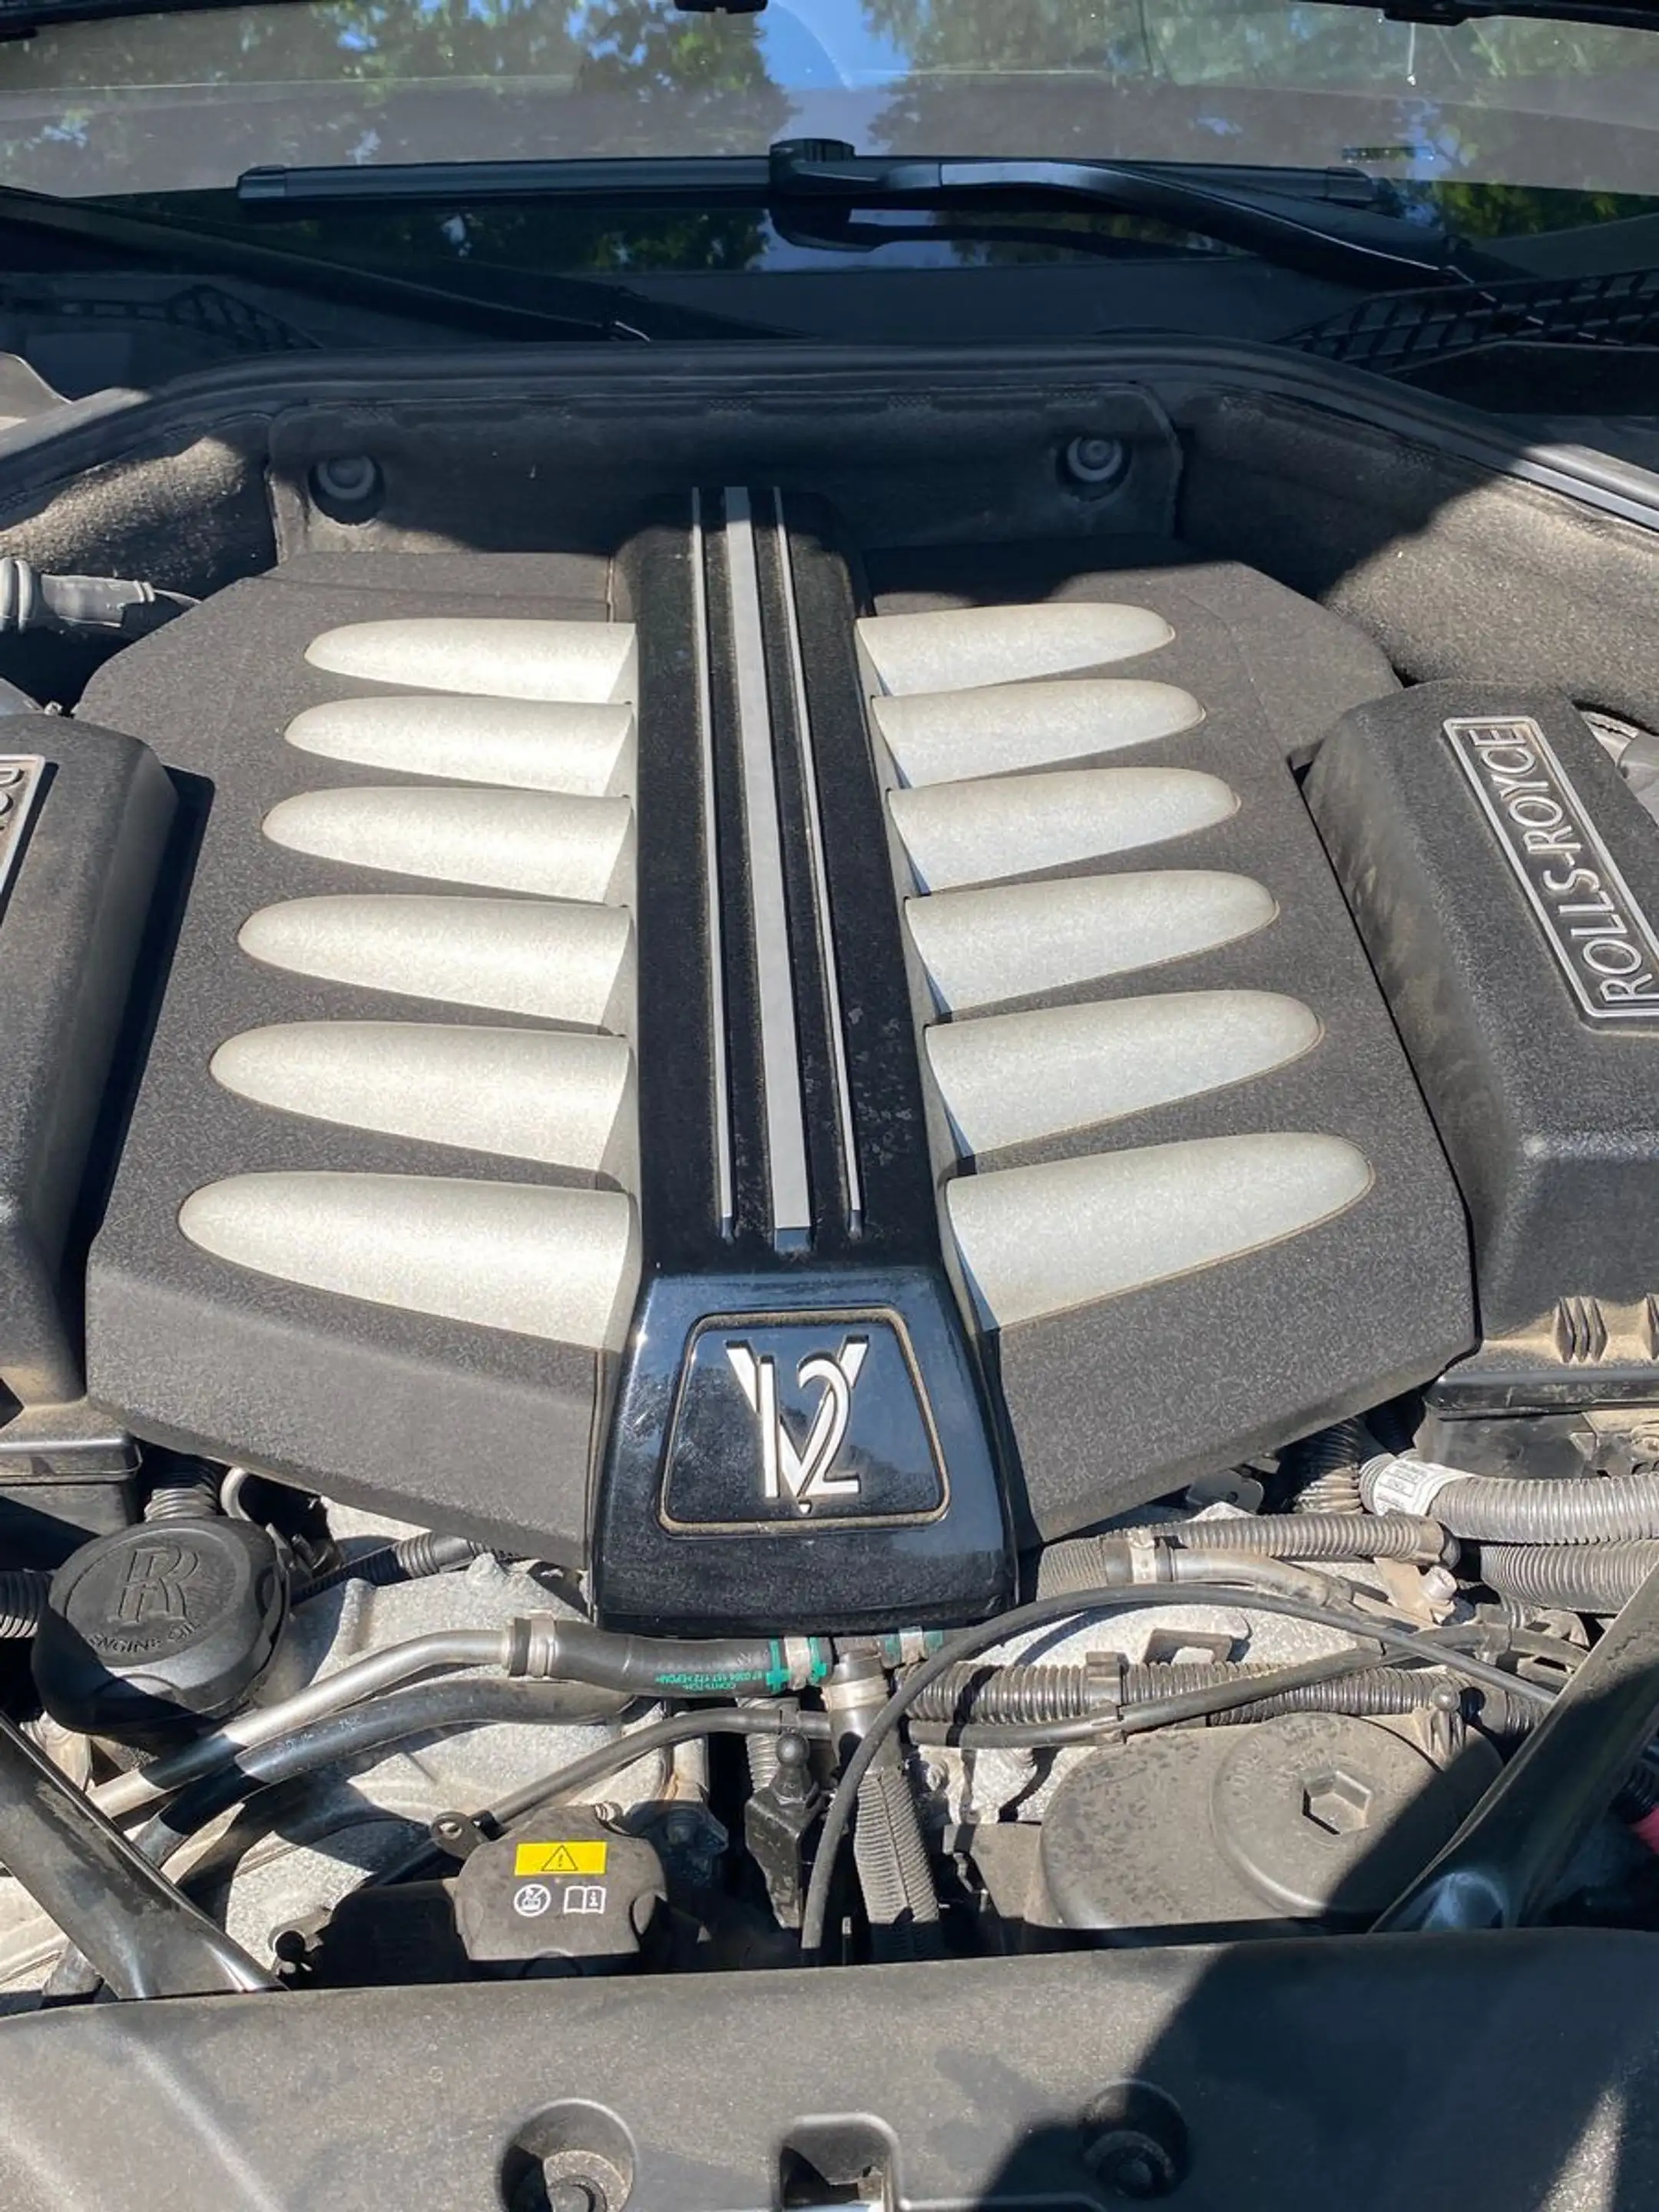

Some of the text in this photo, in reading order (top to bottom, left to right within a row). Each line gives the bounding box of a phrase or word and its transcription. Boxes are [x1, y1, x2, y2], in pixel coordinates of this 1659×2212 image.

[1469, 728, 1659, 1002] ROLLS-ROYCE
[85, 1619, 204, 1654] ENGINE OIL
